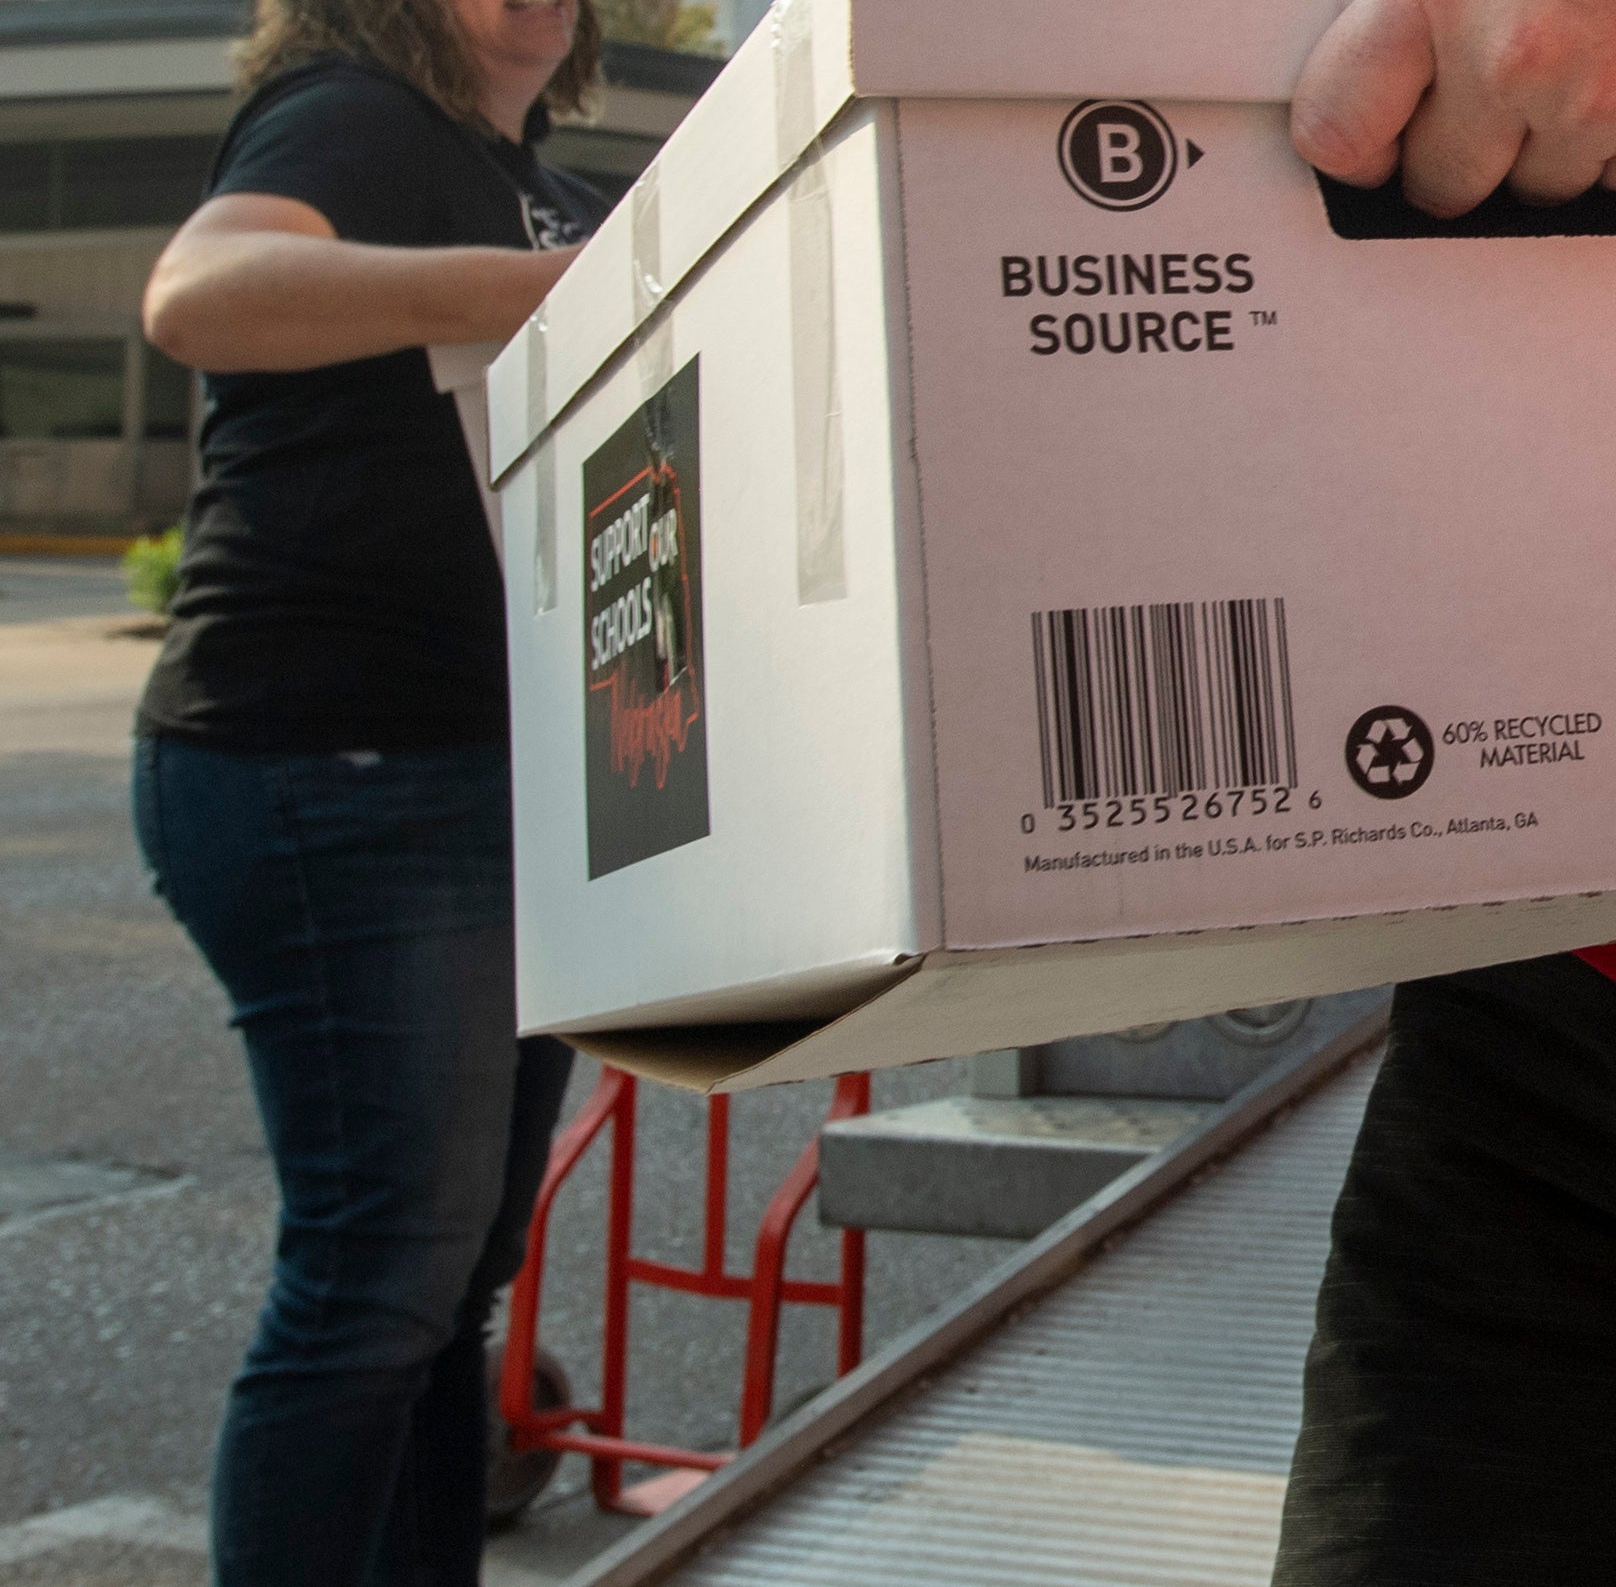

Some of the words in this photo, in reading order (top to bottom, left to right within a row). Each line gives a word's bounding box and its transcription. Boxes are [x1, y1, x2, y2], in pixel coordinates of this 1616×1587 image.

[1096, 122, 1143, 184] B
[1001, 252, 1255, 298] BUSINESS
[1030, 311, 1235, 355] SOURCE
[591, 492, 651, 593] SUPPORT
[649, 508, 679, 573] OUR
[591, 576, 652, 671] SCHOOLS
[1442, 720, 1488, 745] 60%
[1494, 713, 1602, 740] RECYCLED
[1480, 740, 1585, 768] MATERIAL
[1025, 844, 1150, 874] Manufactured
[1155, 843, 1171, 861] in
[1175, 842, 1203, 859] the
[1208, 835, 1261, 857] U.S.A.
[1266, 832, 1291, 851] for
[1295, 829, 1328, 849] S.P.
[1332, 823, 1406, 846] Richards
[1410, 819, 1443, 841] Co.,
[1446, 813, 1511, 836] Atlanta,
[1514, 812, 1539, 829] GA
